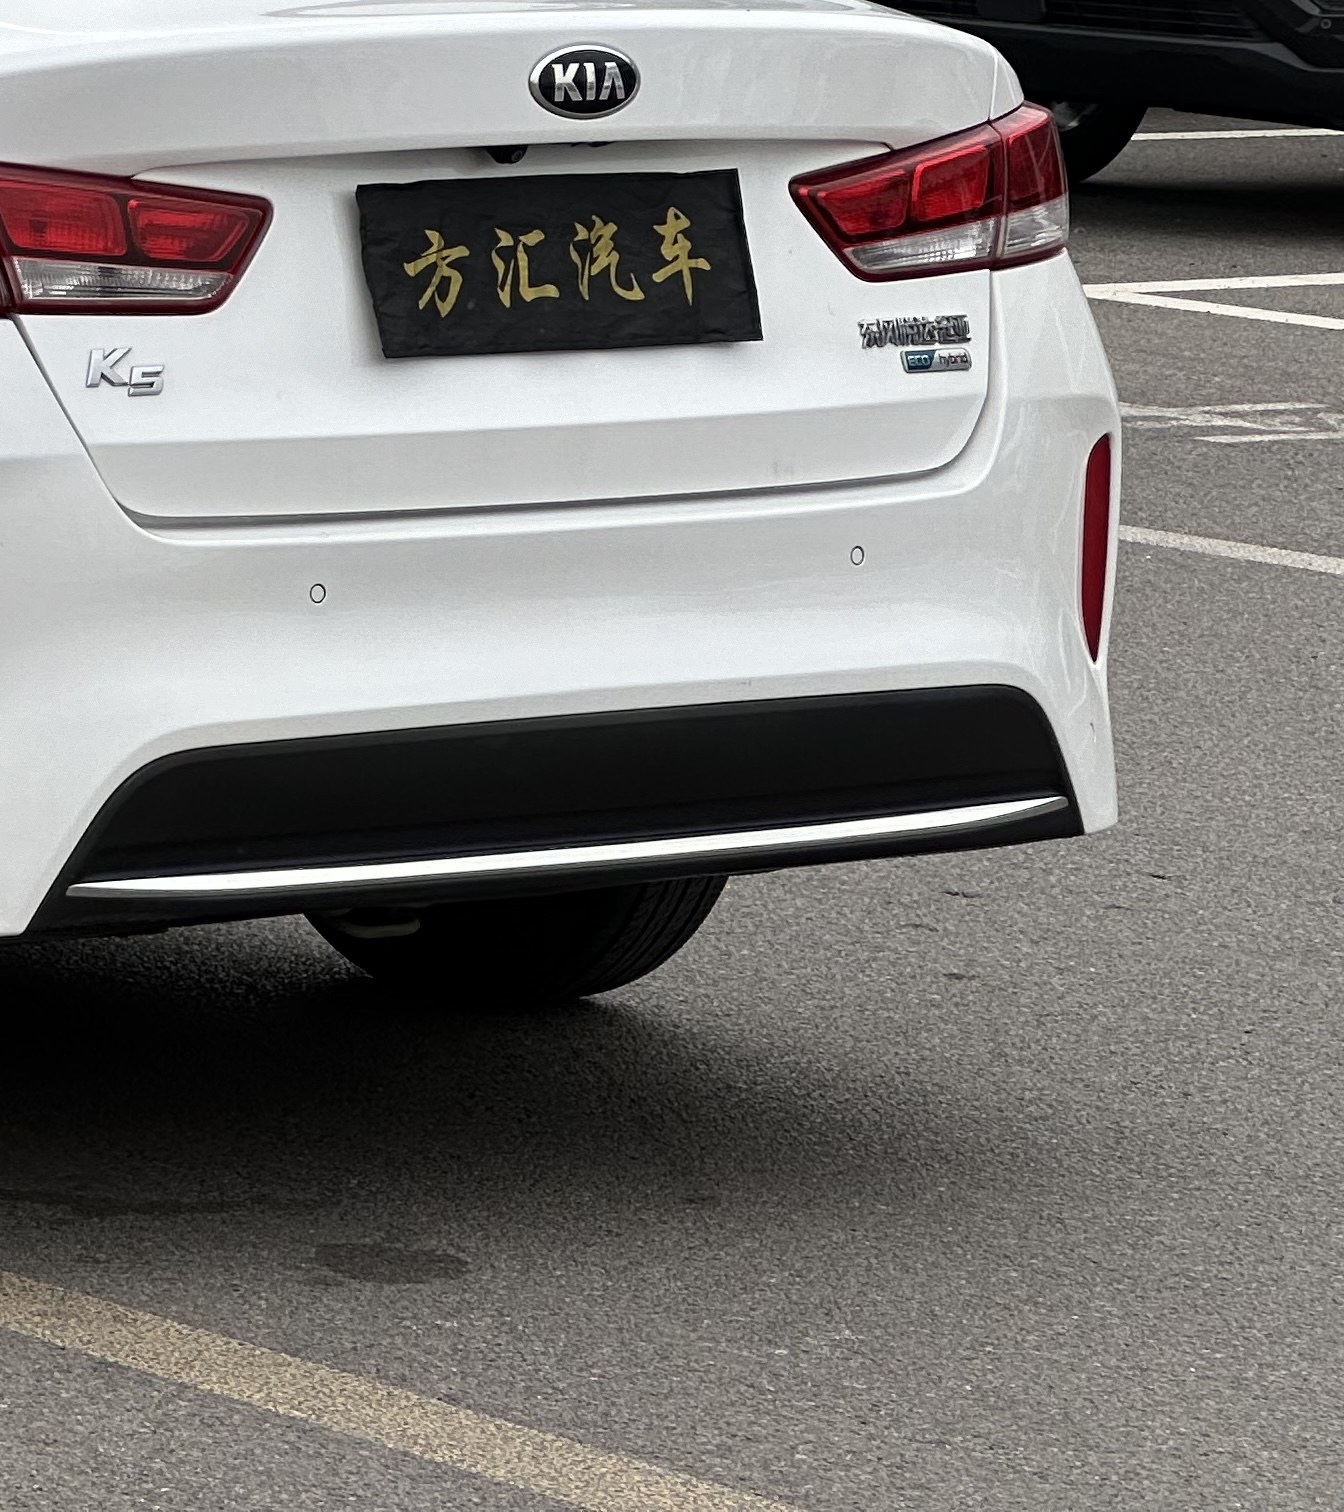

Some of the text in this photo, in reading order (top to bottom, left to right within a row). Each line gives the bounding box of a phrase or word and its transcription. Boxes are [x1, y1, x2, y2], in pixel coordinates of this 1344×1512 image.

[552, 61, 625, 102] KIA
[403, 206, 711, 318] 方汇汽车
[86, 347, 165, 397] K5
